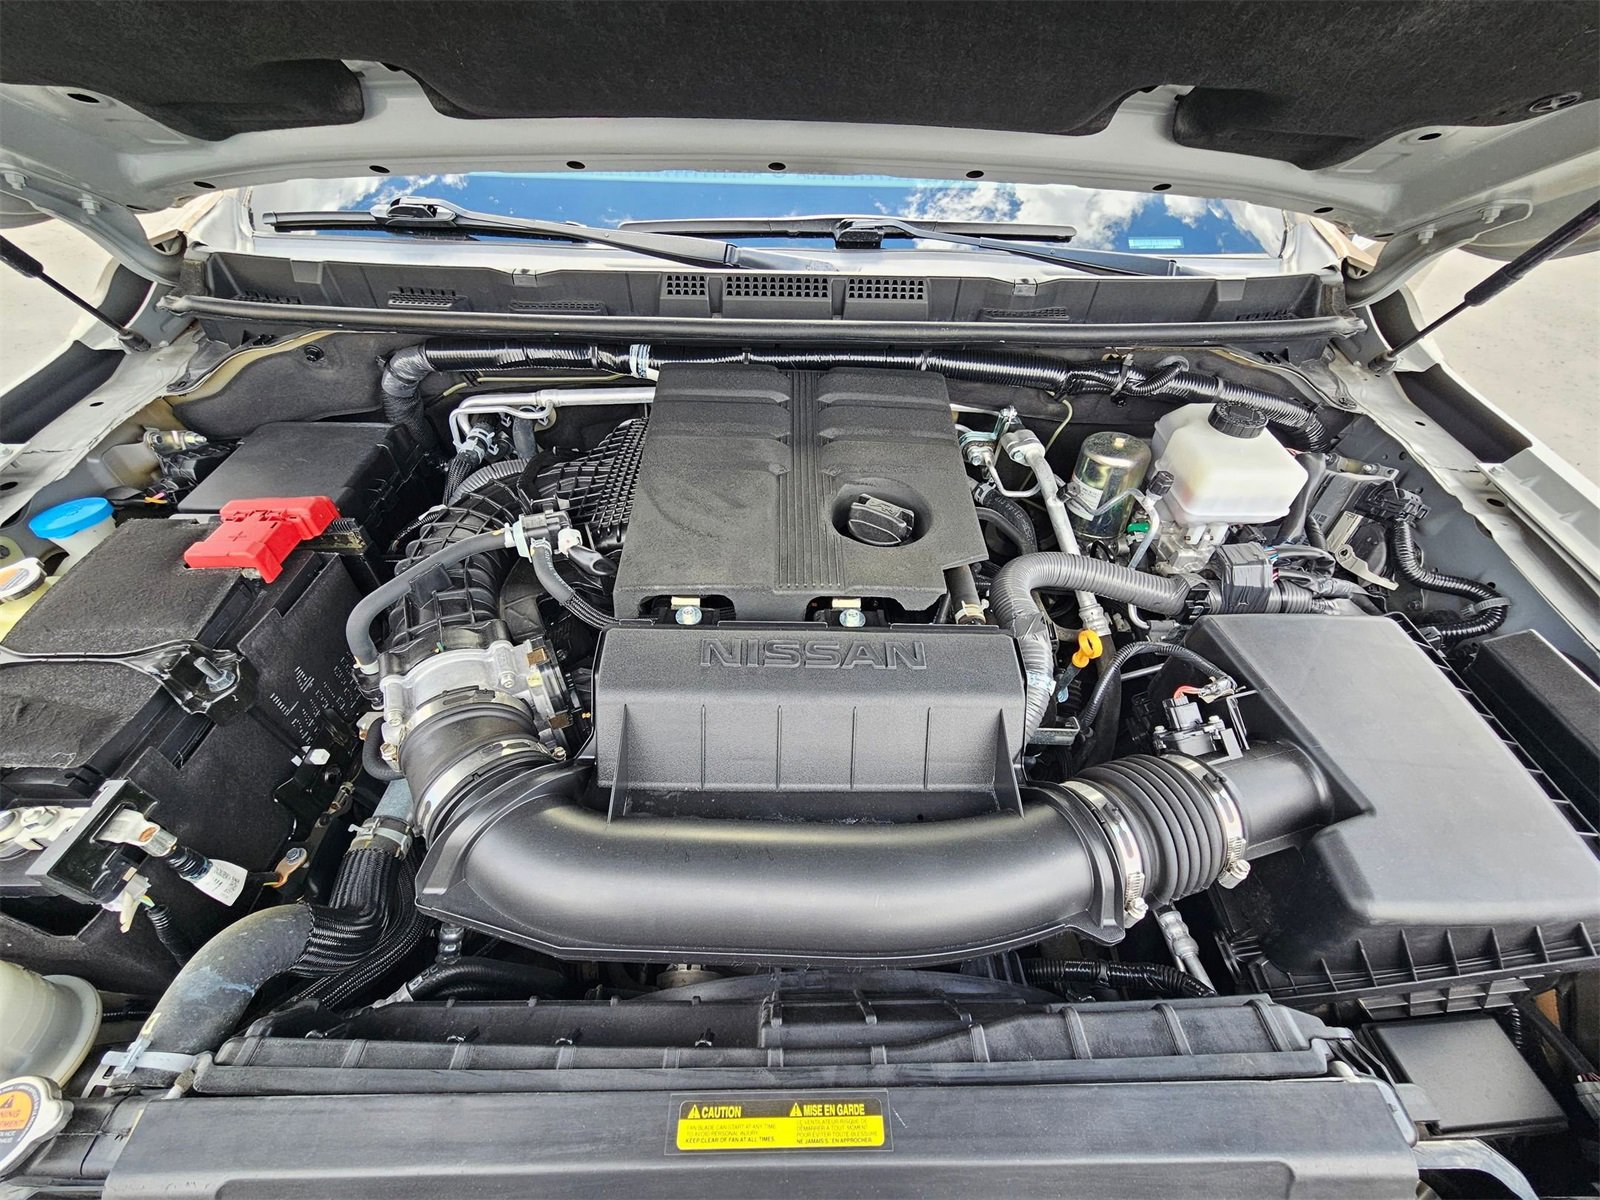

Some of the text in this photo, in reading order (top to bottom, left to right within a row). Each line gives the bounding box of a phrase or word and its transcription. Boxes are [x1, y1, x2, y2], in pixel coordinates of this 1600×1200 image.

[700, 638, 927, 670] NISSAN
[701, 1106, 742, 1119] CAUTION
[803, 1103, 865, 1117] MISE EN GARDE
